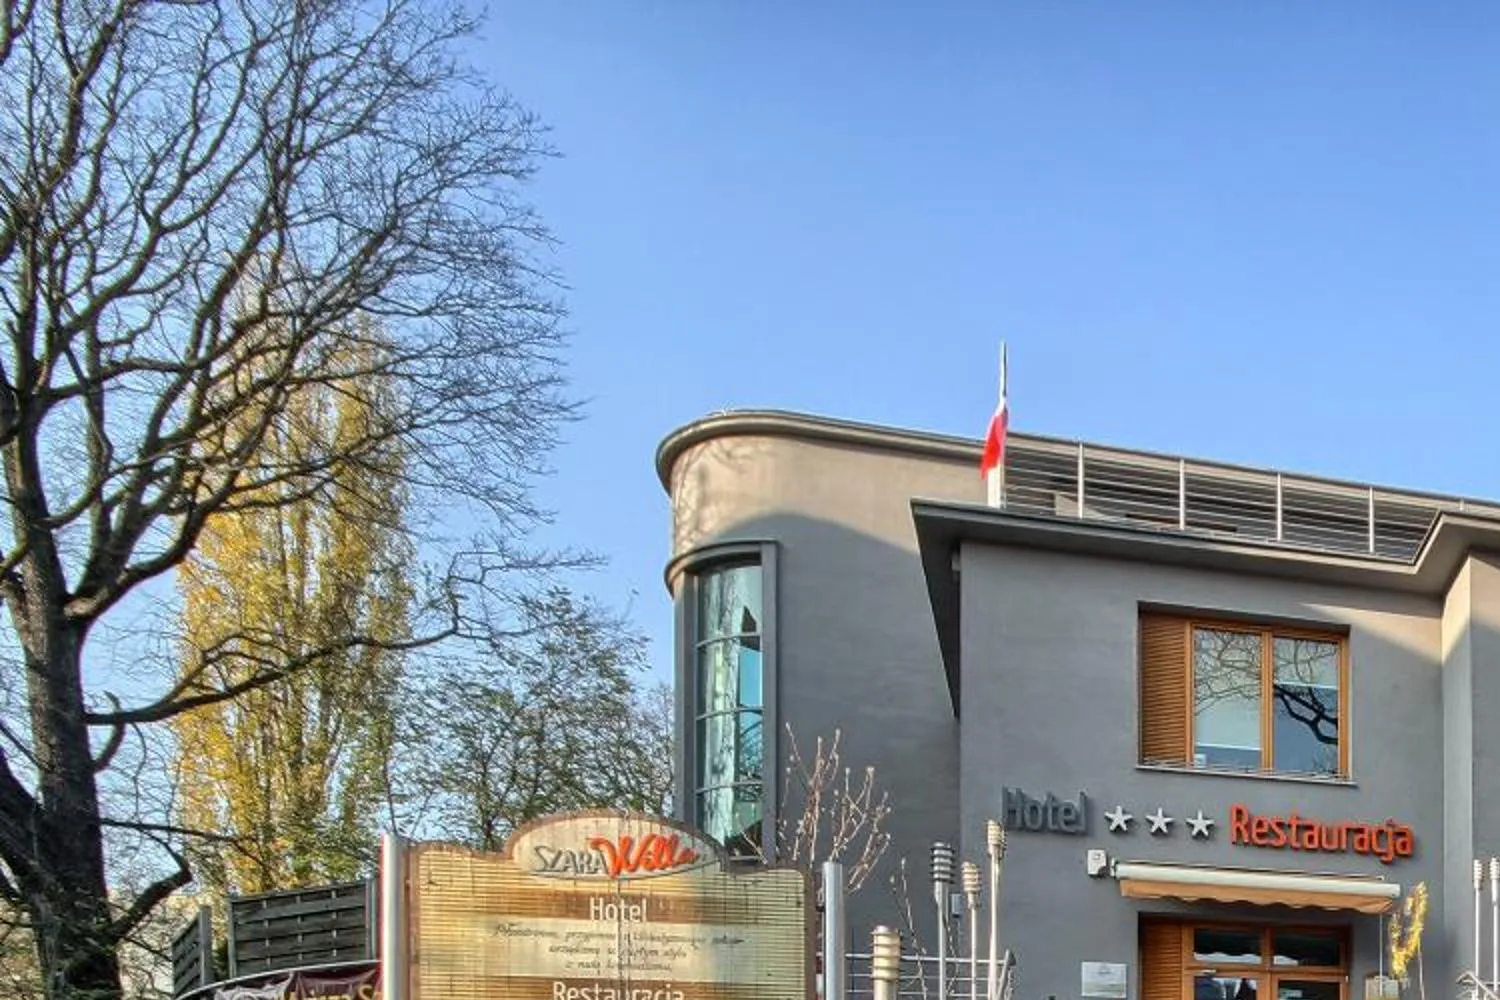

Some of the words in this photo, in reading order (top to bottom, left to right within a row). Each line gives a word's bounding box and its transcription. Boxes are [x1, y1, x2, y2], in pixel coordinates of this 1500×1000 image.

[1001, 786, 1087, 834] Hotel
[1230, 805, 1415, 863] Restauracja
[588, 897, 648, 923] Hotel
